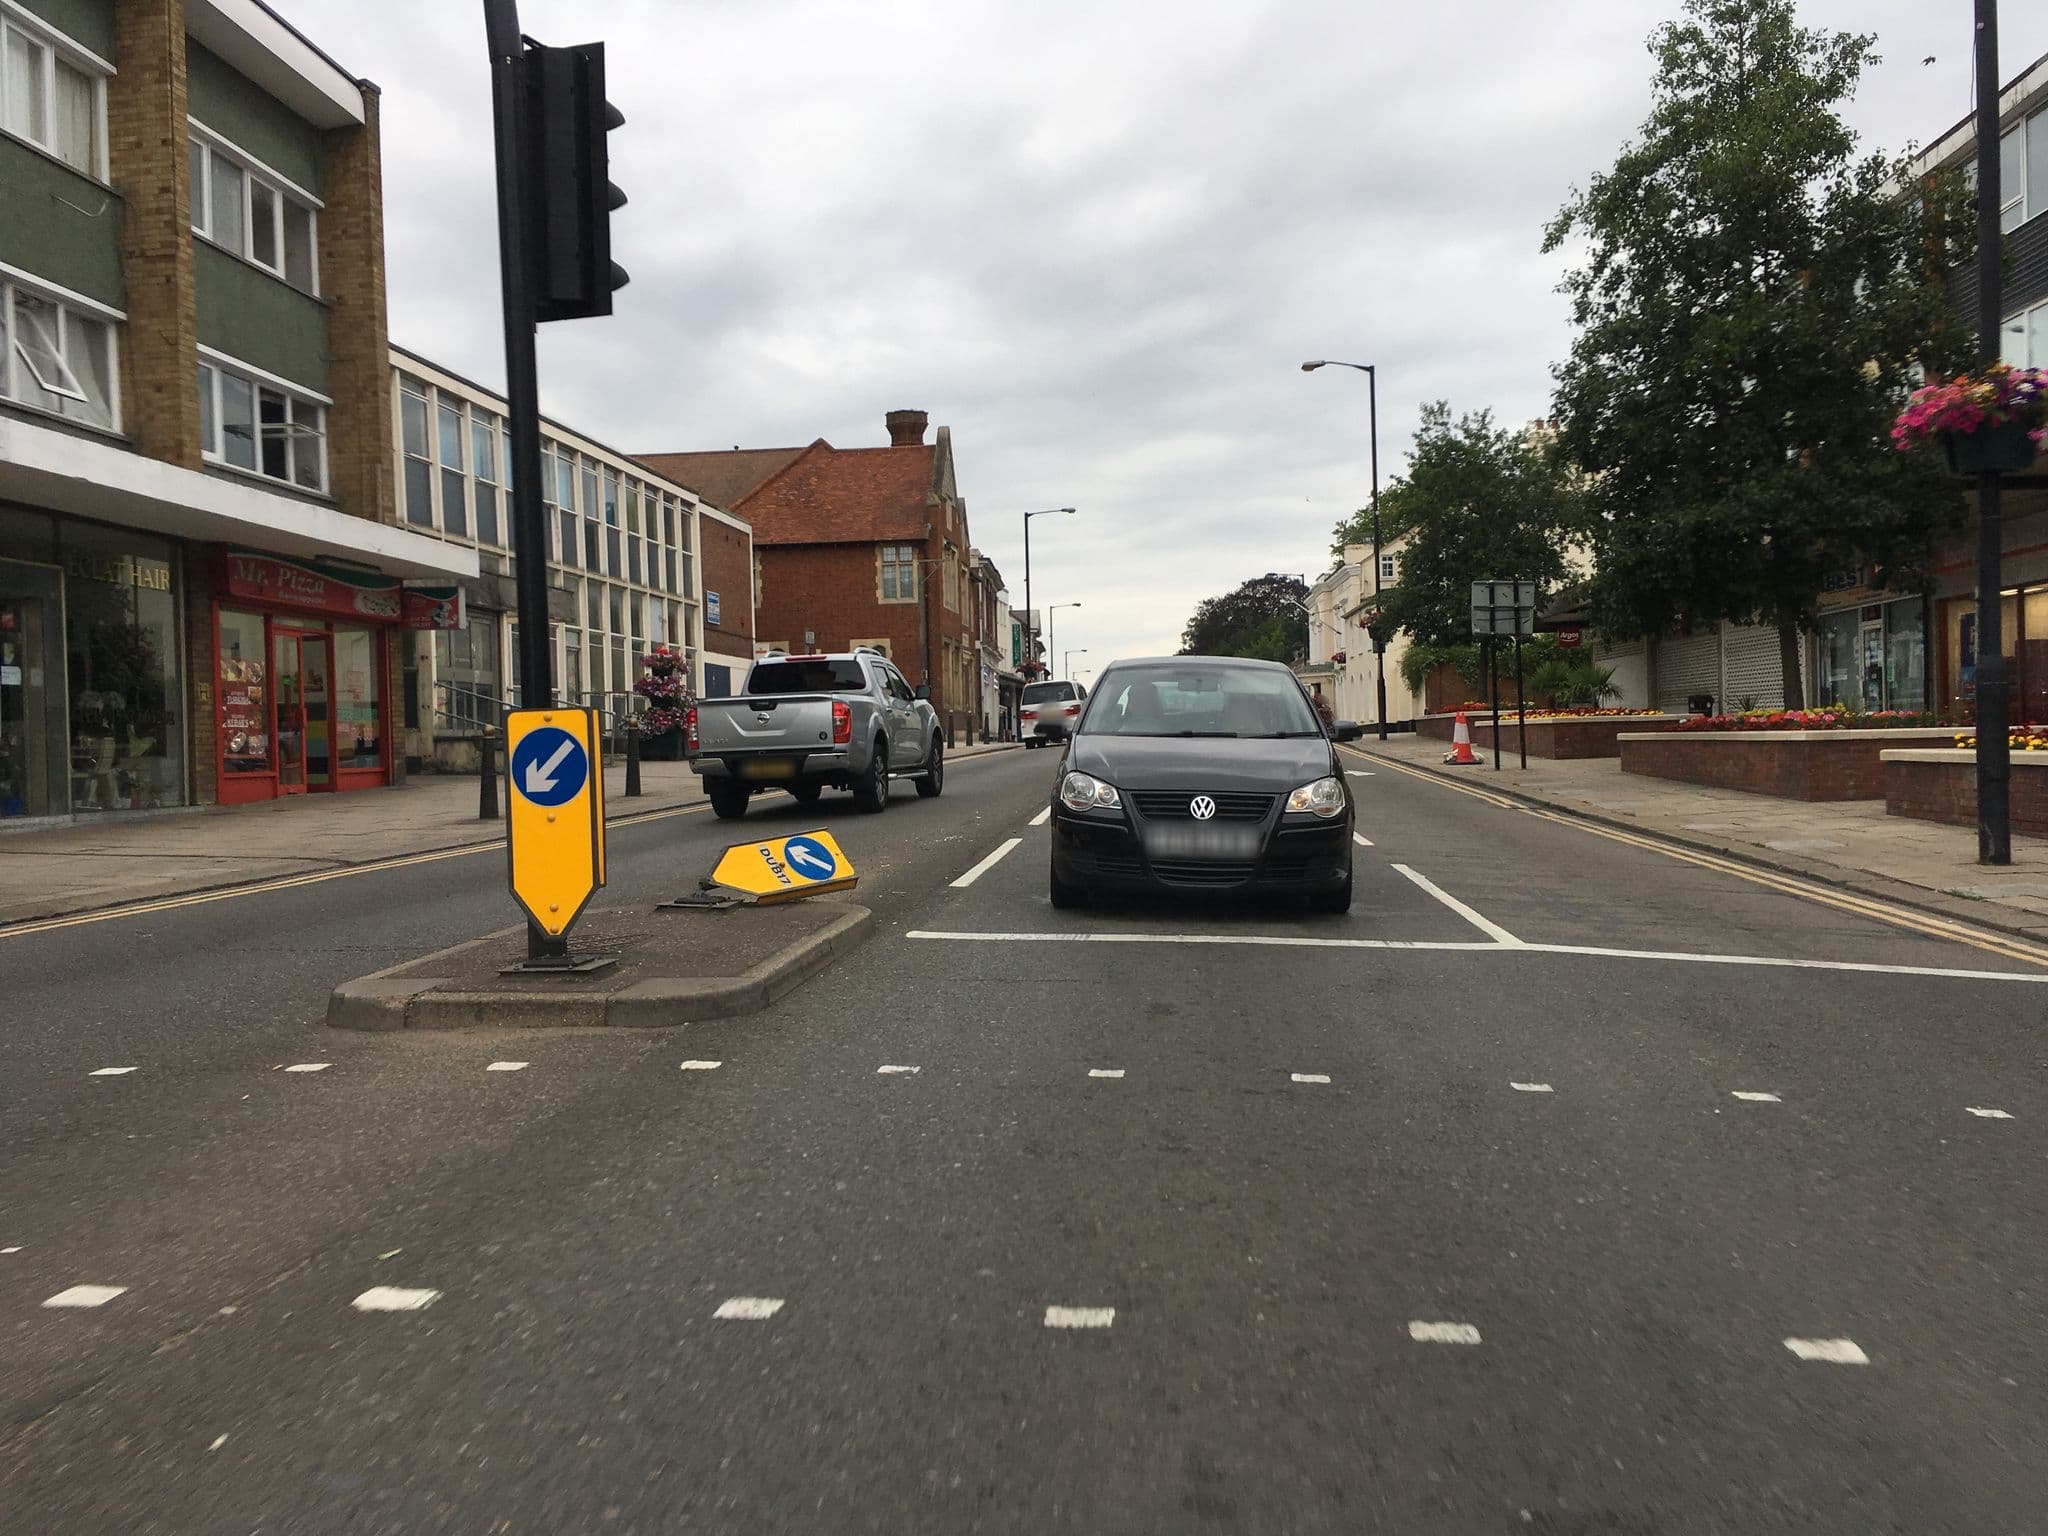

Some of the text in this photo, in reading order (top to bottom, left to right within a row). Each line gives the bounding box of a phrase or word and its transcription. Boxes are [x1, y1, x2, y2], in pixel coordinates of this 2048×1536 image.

[129, 564, 169, 591] HAIR
[234, 559, 326, 593] Mr. Pizza
[1560, 631, 1580, 640] Argos
[1190, 796, 1215, 820] VW
[760, 848, 792, 884] DUB17
